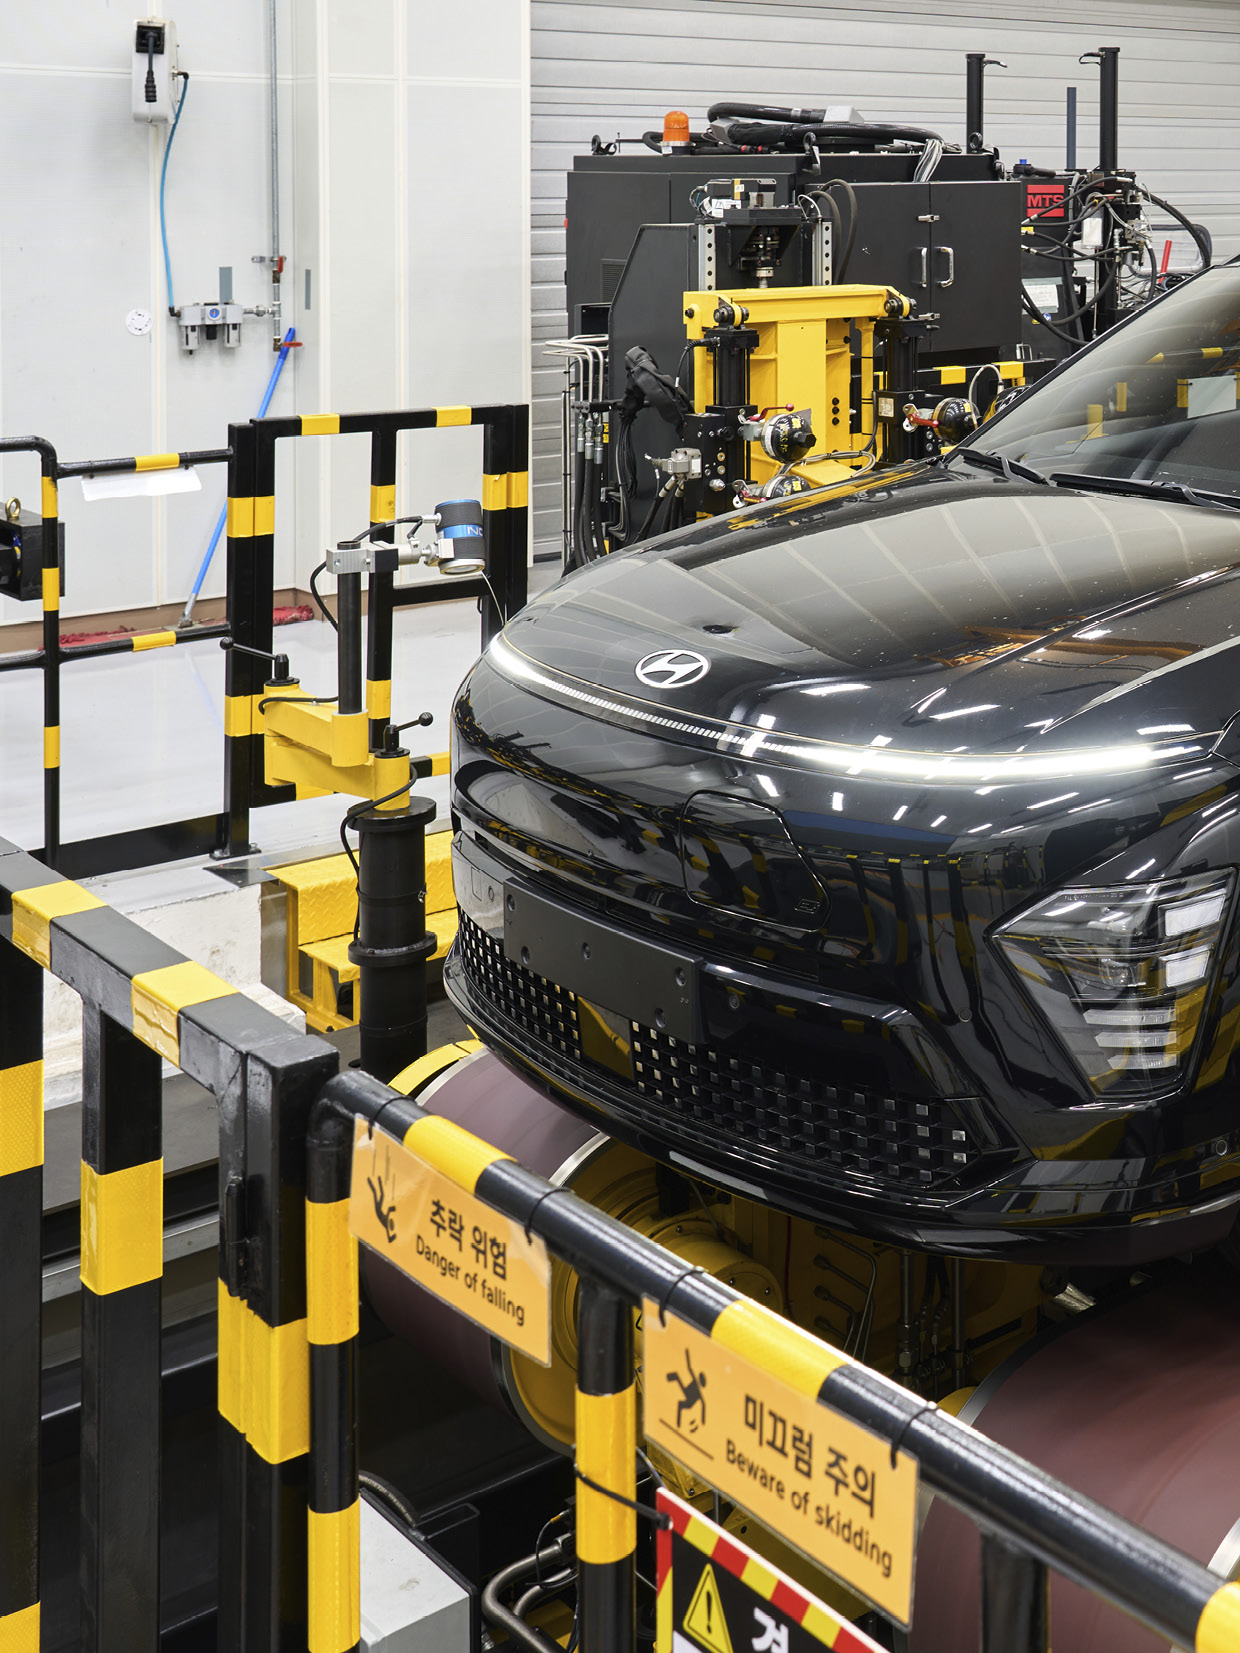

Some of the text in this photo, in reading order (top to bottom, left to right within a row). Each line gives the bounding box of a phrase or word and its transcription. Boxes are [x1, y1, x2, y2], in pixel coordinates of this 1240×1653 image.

[1027, 195, 1064, 207] MTS
[416, 1234, 524, 1327] Danger of falling
[430, 1199, 507, 1281] 추락 위험
[745, 1393, 875, 1519] 미끄럼 주의
[727, 1438, 892, 1578] Beware of skidding
